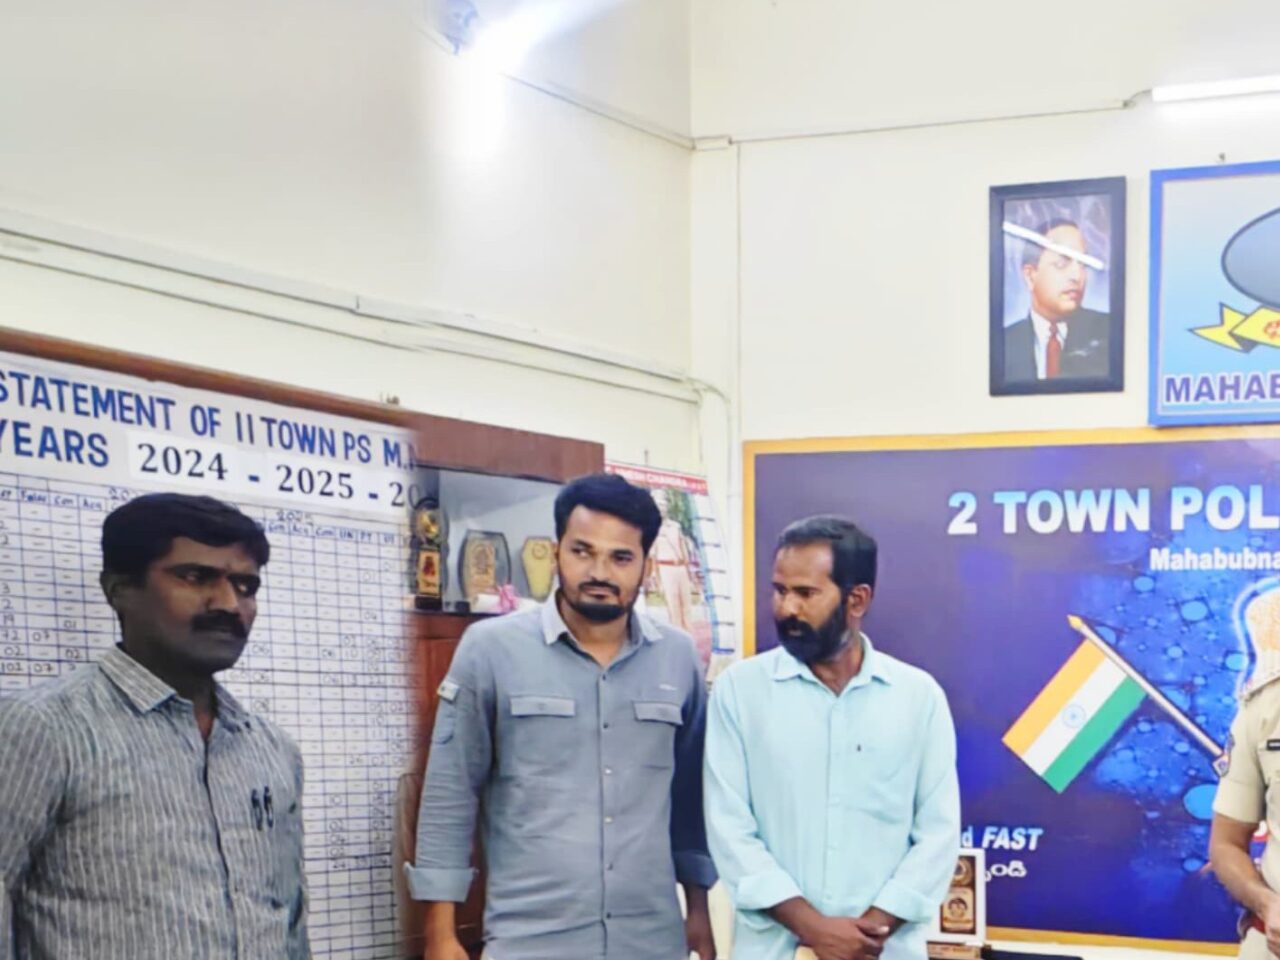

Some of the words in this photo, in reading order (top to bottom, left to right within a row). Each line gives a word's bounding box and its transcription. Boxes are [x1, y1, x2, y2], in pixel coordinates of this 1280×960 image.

[190, 405, 222, 438] OF
[260, 416, 336, 458] TOWN
[343, 431, 372, 464] PS
[138, 442, 228, 481] 2024
[276, 464, 354, 499] 2025
[947, 491, 978, 535] 2
[993, 488, 1149, 534] TOWN
[982, 825, 1044, 851] FAST
